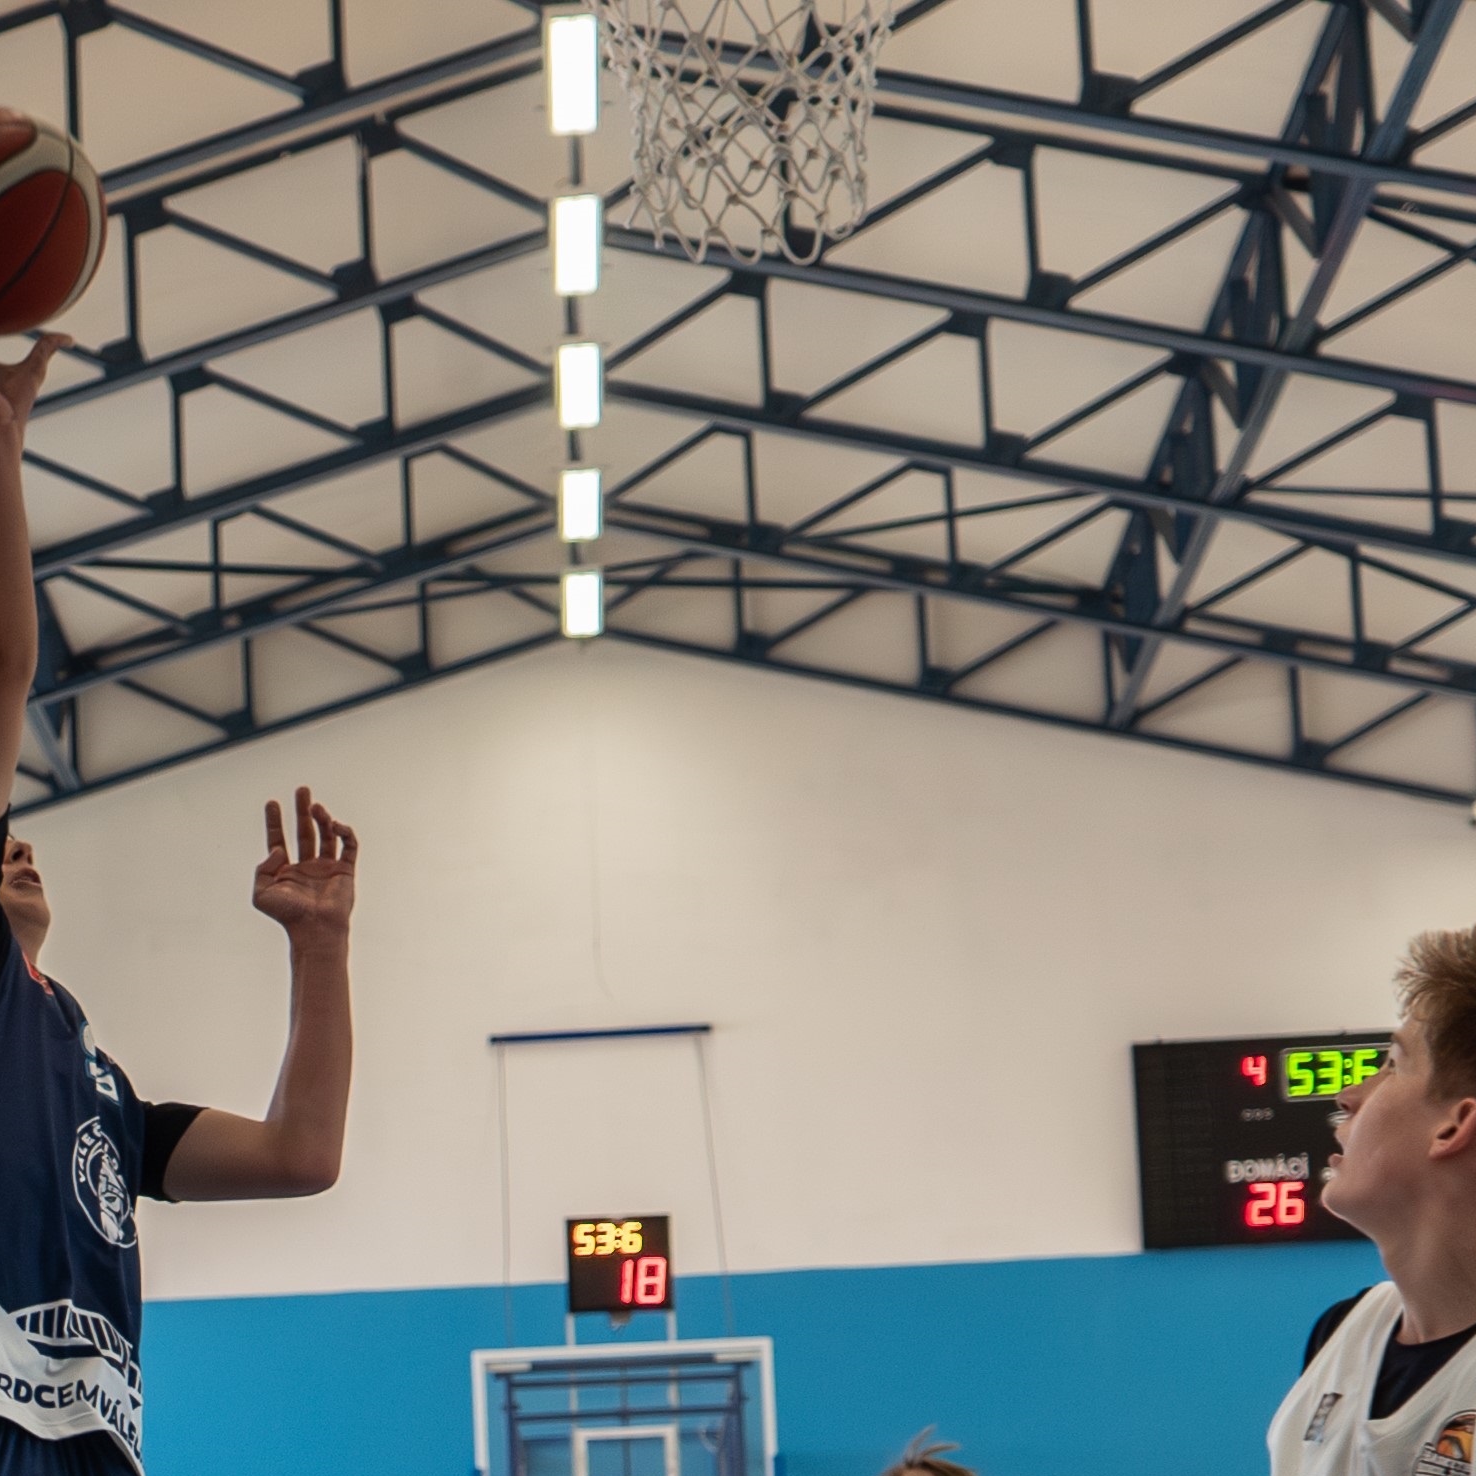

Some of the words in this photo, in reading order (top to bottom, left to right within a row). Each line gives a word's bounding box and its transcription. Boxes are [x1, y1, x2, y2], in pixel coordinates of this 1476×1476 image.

[1240, 1055, 1267, 1086] 4
[1245, 1181, 1306, 1227] 26
[573, 1221, 643, 1257] 53:6
[620, 1256, 668, 1305] 18
